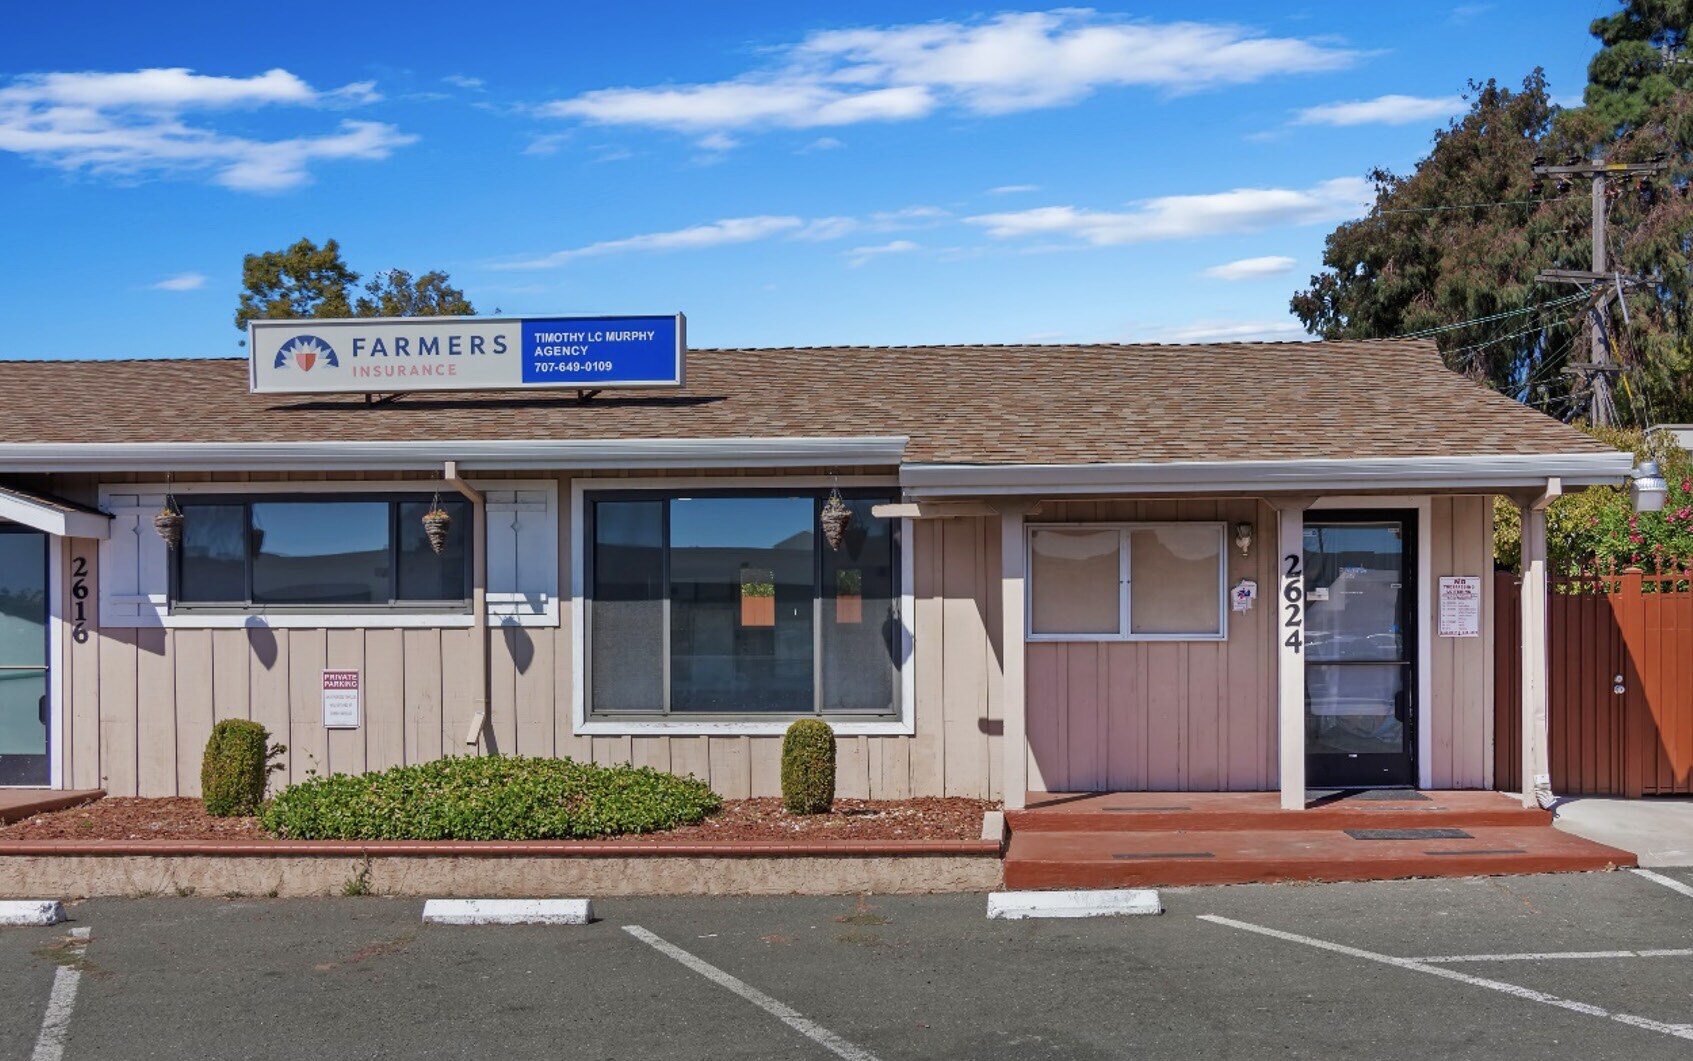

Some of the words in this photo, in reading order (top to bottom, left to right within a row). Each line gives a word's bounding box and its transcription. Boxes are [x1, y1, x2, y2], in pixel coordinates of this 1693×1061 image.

[534, 332, 585, 343] TIMOTHY
[587, 331, 603, 342] LC
[605, 330, 655, 342] MURPHY
[352, 334, 508, 358] FARMERS
[534, 345, 589, 357] AGENCY
[352, 363, 457, 378] INSURANCE
[534, 361, 613, 373] 707-649-0109
[72, 556, 89, 645] 2616
[1283, 554, 1303, 654] 2624
[324, 673, 358, 681] PRIVATE
[324, 680, 358, 688] PARKING
